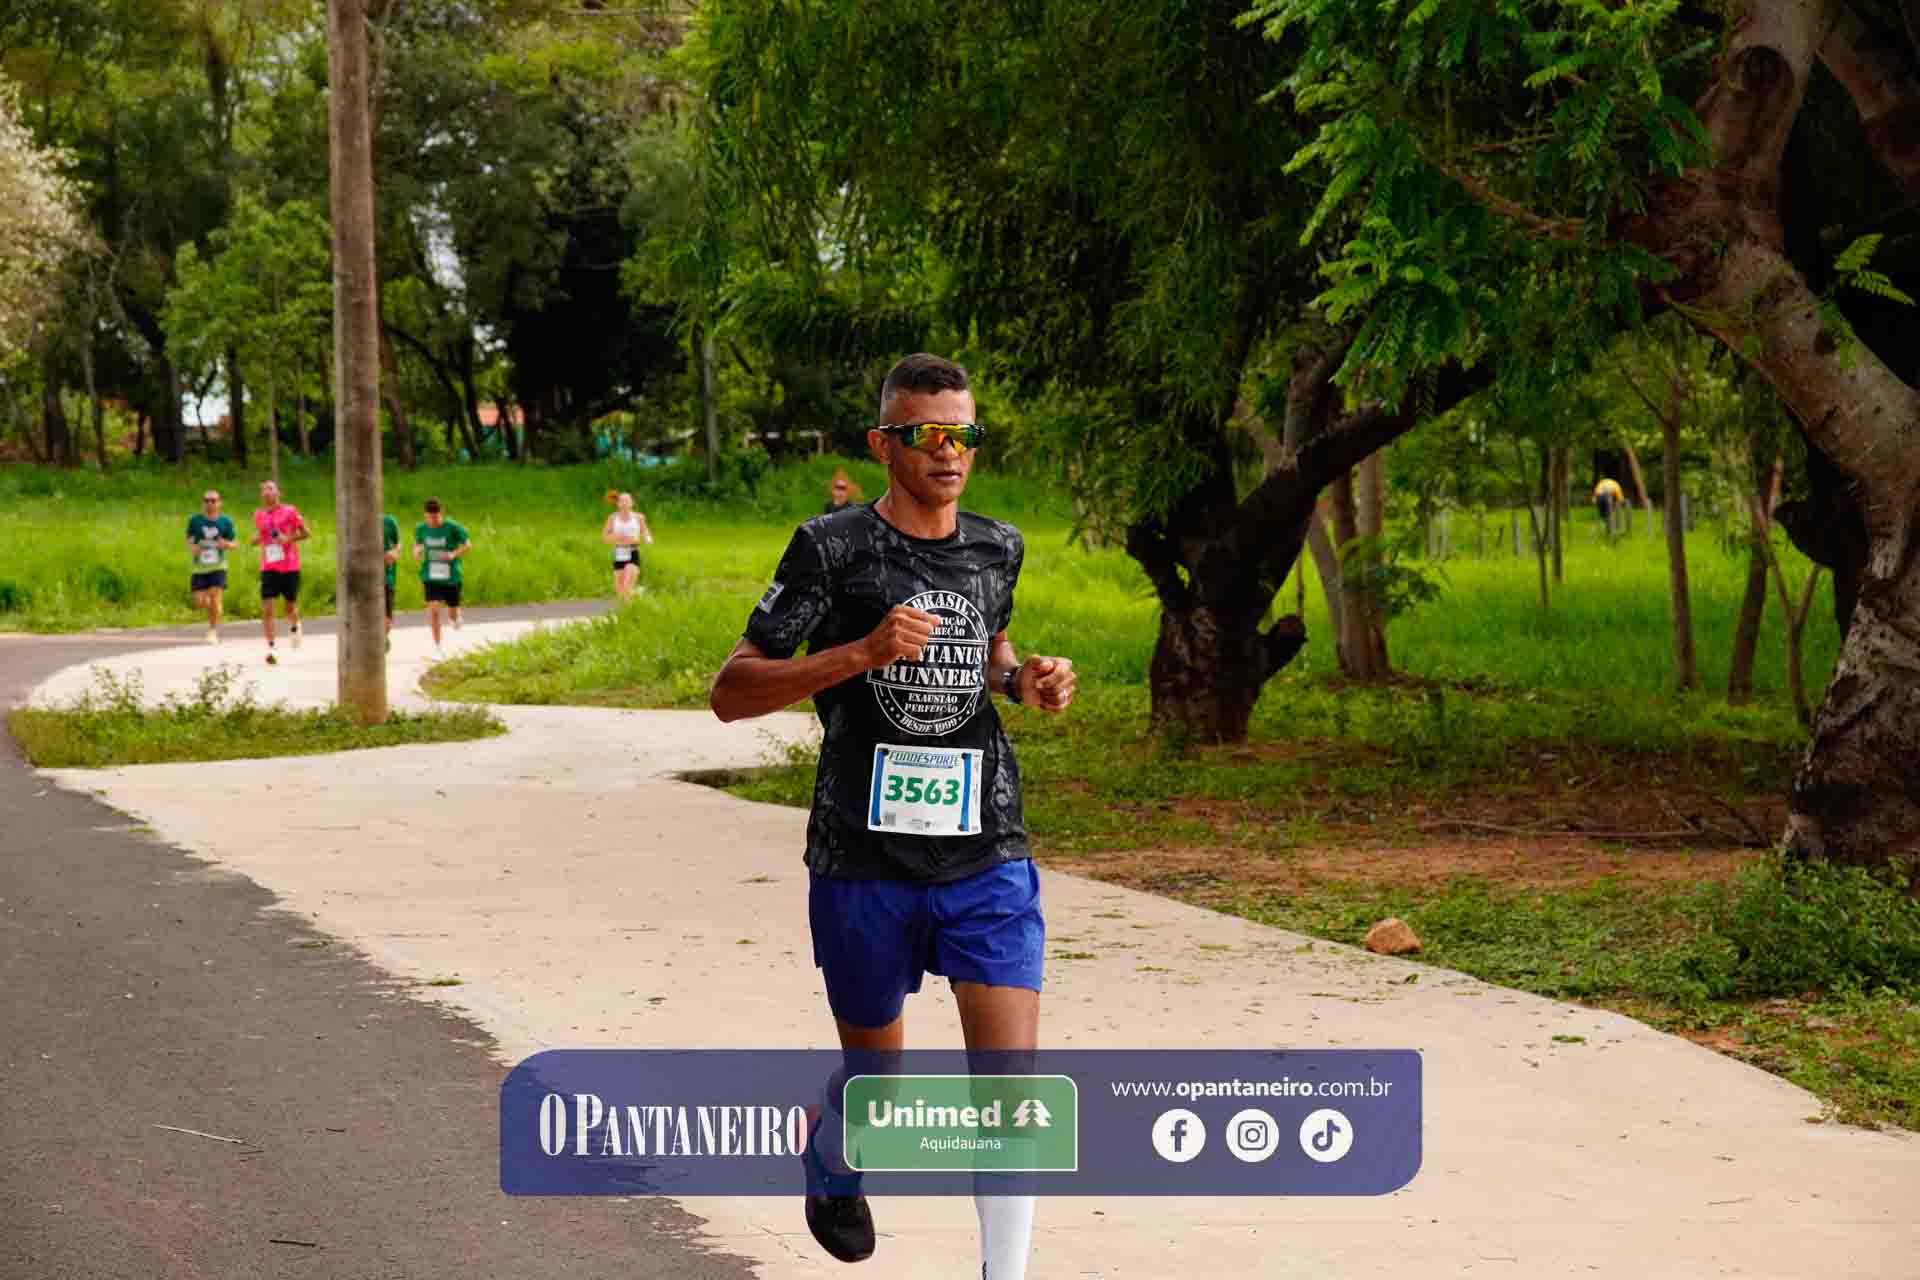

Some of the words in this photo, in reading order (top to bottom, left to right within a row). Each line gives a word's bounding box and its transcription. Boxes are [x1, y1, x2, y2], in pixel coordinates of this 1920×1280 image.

[911, 593, 968, 614] BRASIL
[897, 644, 983, 665] NTANUS
[883, 665, 985, 687] RUNNERS
[908, 692, 958, 704] EXAUSTÃO
[905, 703, 958, 714] PERFEIÇÃO
[900, 715, 933, 732] DESDE
[887, 751, 961, 766] FUNDESPORTE
[884, 774, 960, 806] 3563
